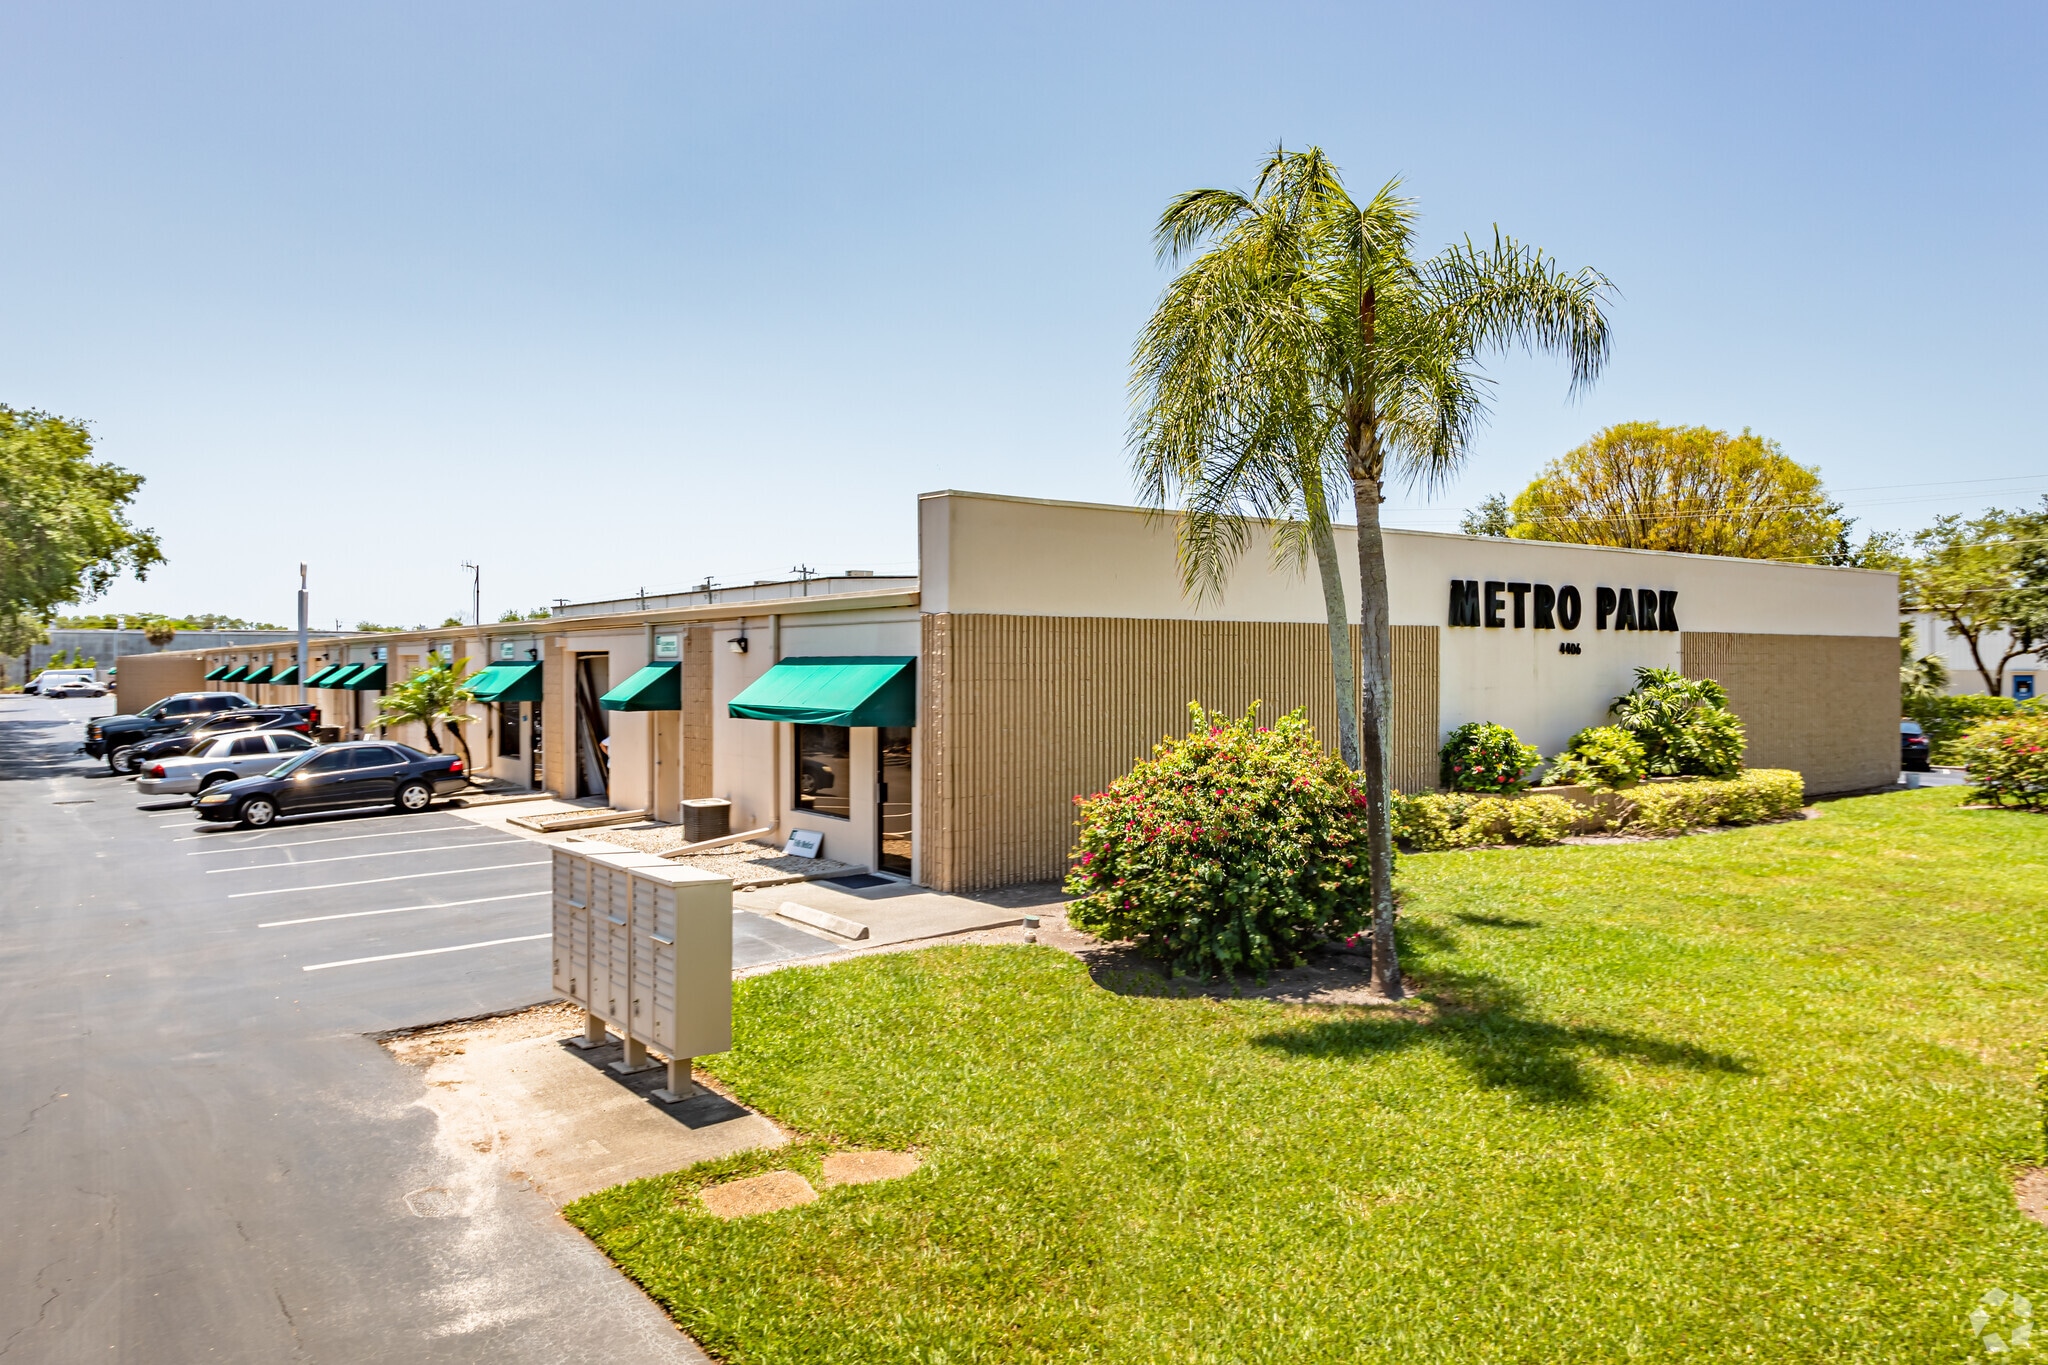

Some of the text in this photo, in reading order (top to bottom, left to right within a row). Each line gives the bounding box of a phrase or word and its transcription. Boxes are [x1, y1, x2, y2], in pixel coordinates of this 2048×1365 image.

[1448, 579, 1679, 631] METRO PARK
[1559, 642, 1582, 655] 4406
